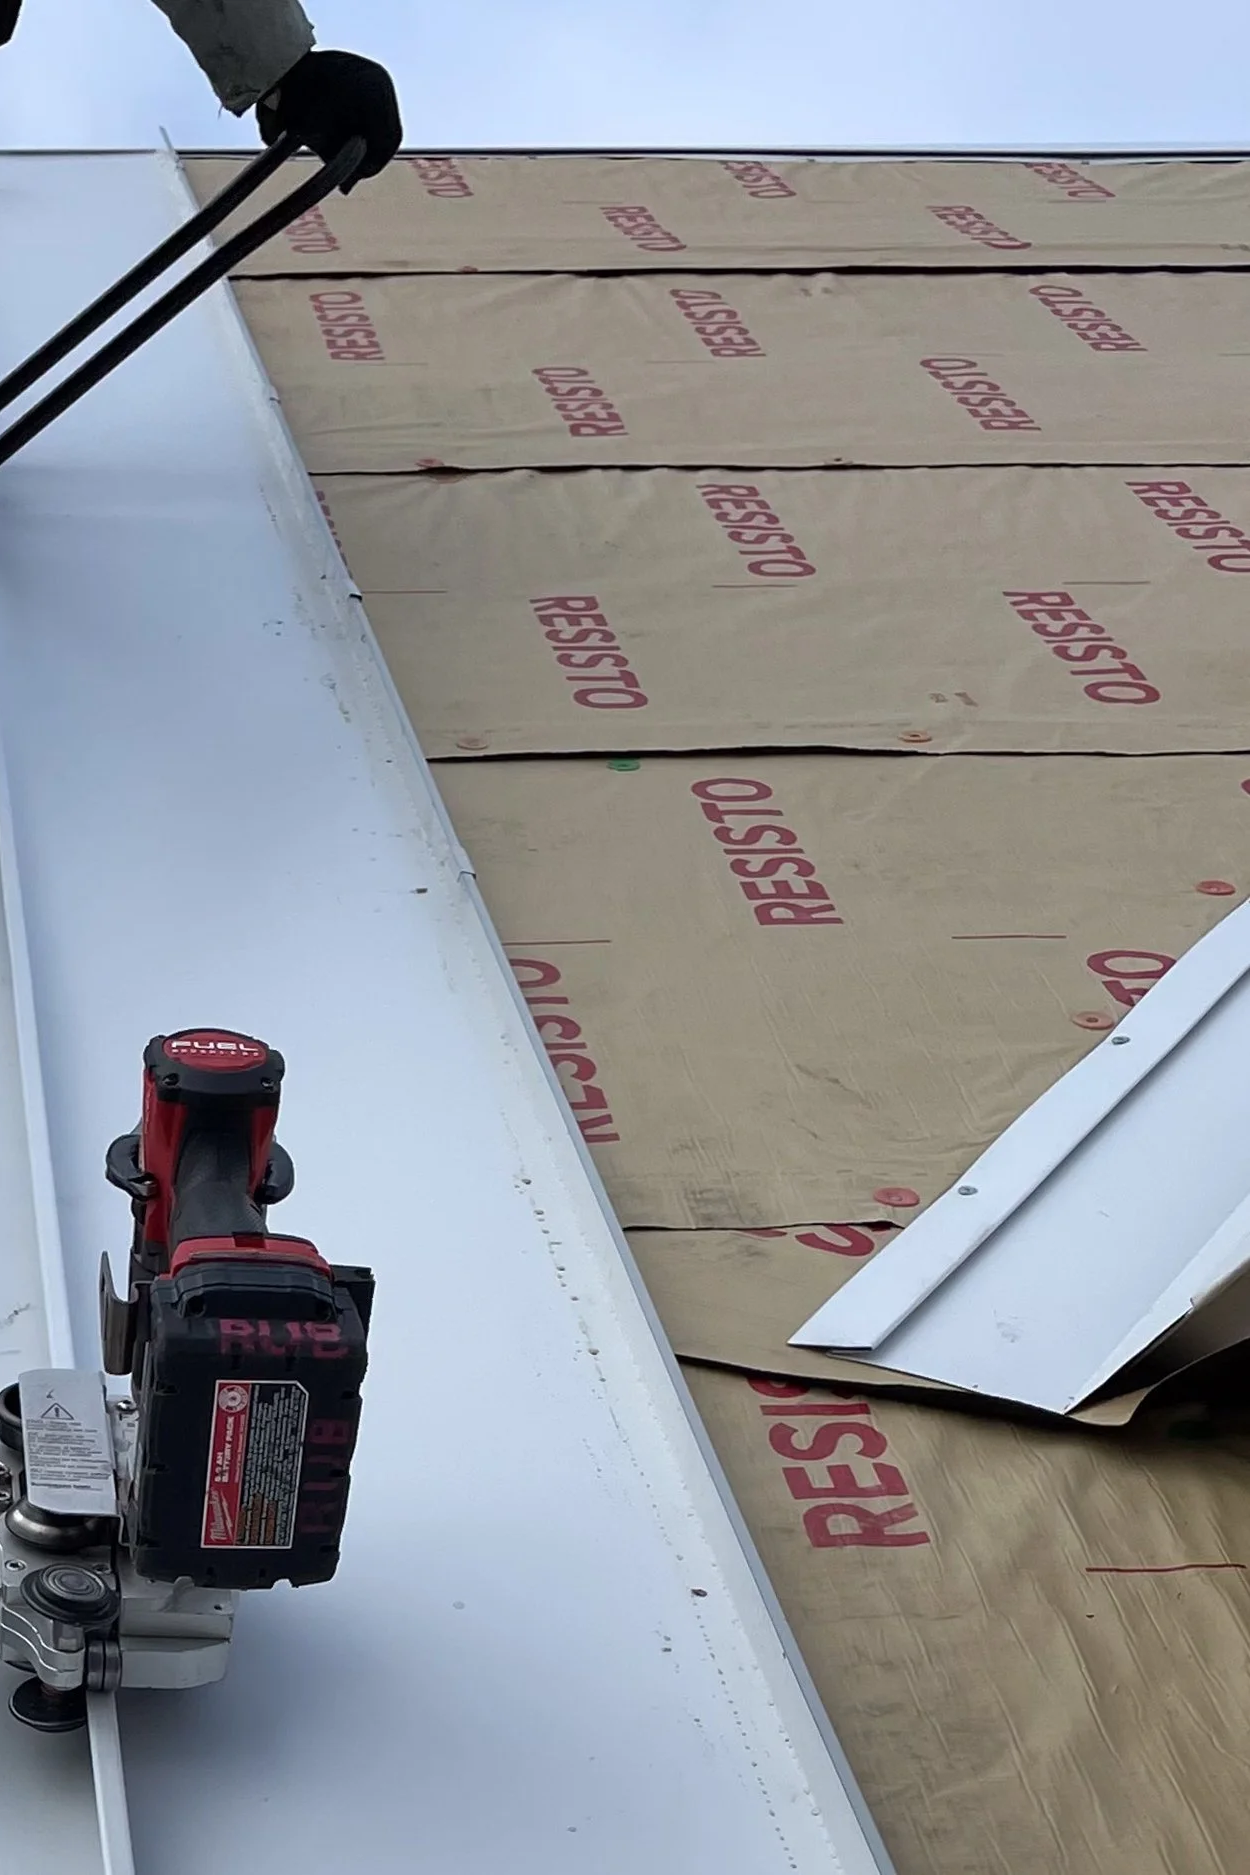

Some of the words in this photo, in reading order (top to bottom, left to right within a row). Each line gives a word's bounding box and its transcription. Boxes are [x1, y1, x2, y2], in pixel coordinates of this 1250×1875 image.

[599, 205, 687, 252] RESISTO
[926, 205, 1032, 249] RESISTO
[309, 290, 385, 361] RESISTO
[669, 288, 766, 357] RESISTO
[1029, 285, 1148, 352] RESISTO
[531, 366, 629, 438] RESISTO
[919, 357, 1042, 431] RESISTO
[695, 484, 817, 577] RESISTO
[1124, 481, 1250, 573] RESISTO
[529, 595, 649, 709] RESISTO
[1002, 591, 1161, 705] RESISTO
[691, 777, 844, 926] RESISTO
[171, 1041, 259, 1051] FUEL
[747, 1377, 931, 1548] RESI
